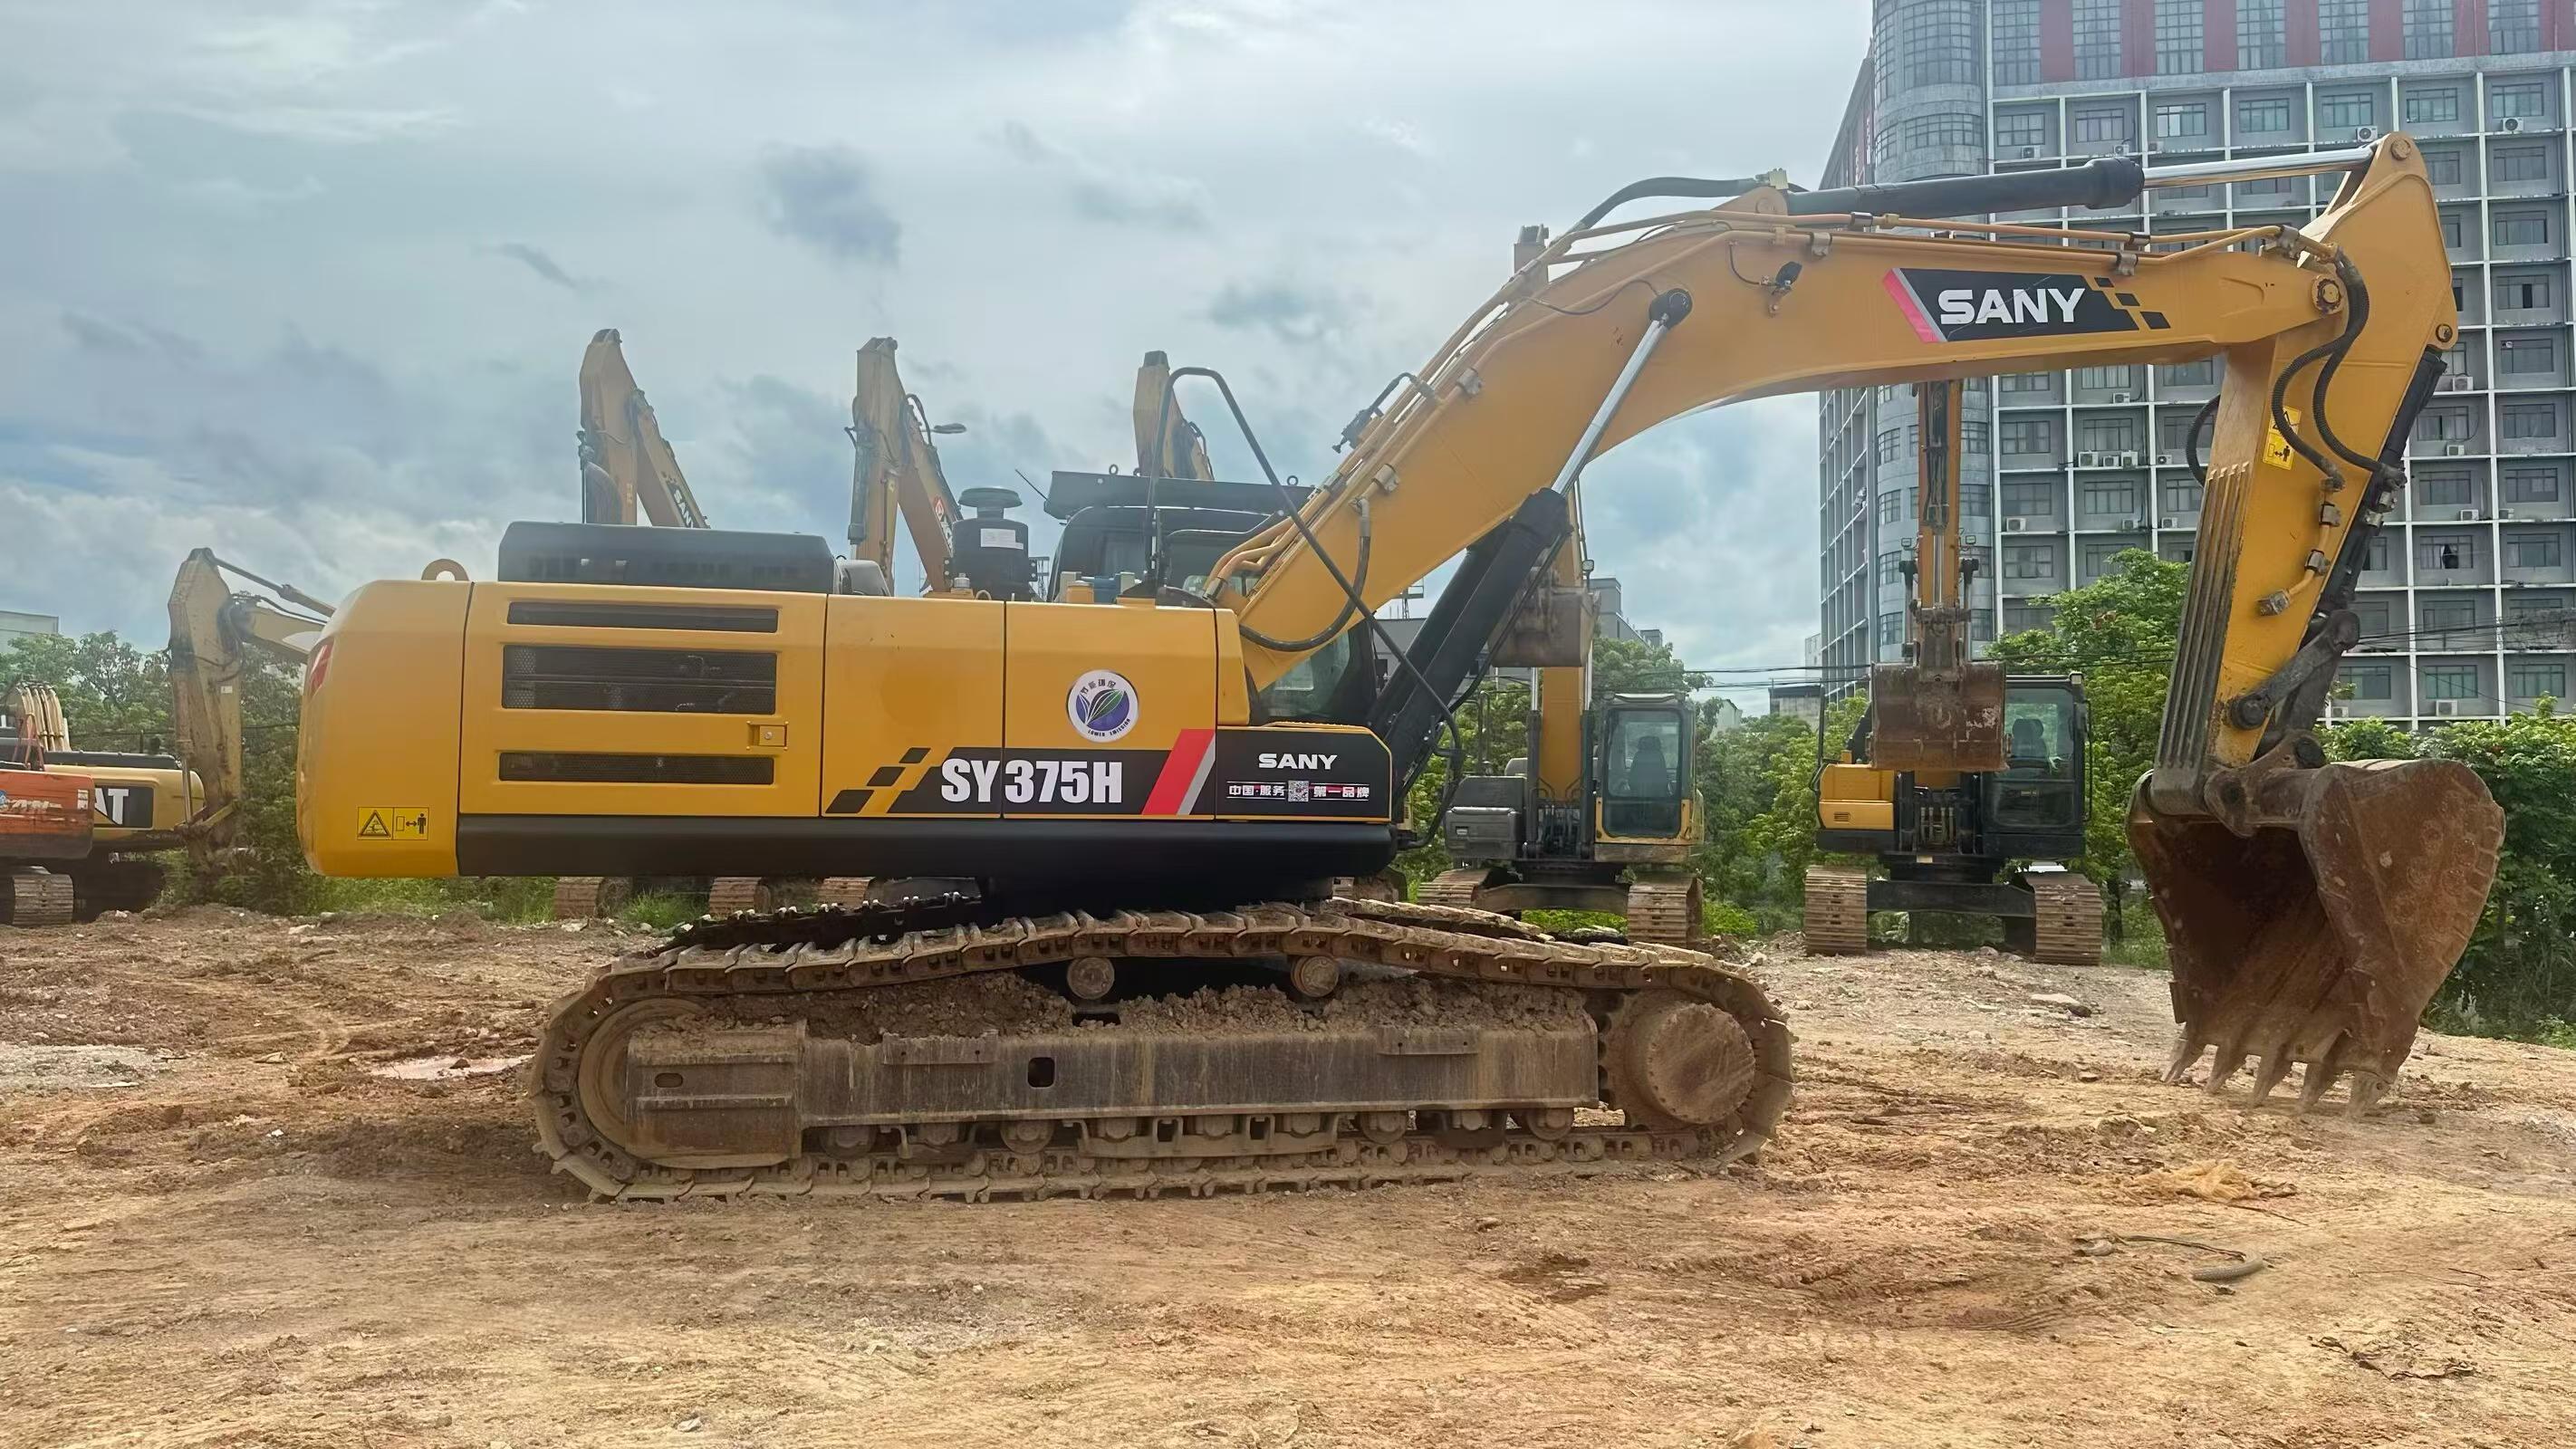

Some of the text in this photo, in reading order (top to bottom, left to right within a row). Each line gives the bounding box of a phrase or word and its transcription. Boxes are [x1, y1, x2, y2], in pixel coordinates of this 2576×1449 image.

[1937, 287, 2085, 325] SANY
[940, 758, 1123, 804] SY375H
[1257, 753, 1338, 771] SANY
[94, 787, 130, 825] AT
[1313, 785, 1370, 799] 第一品牌
